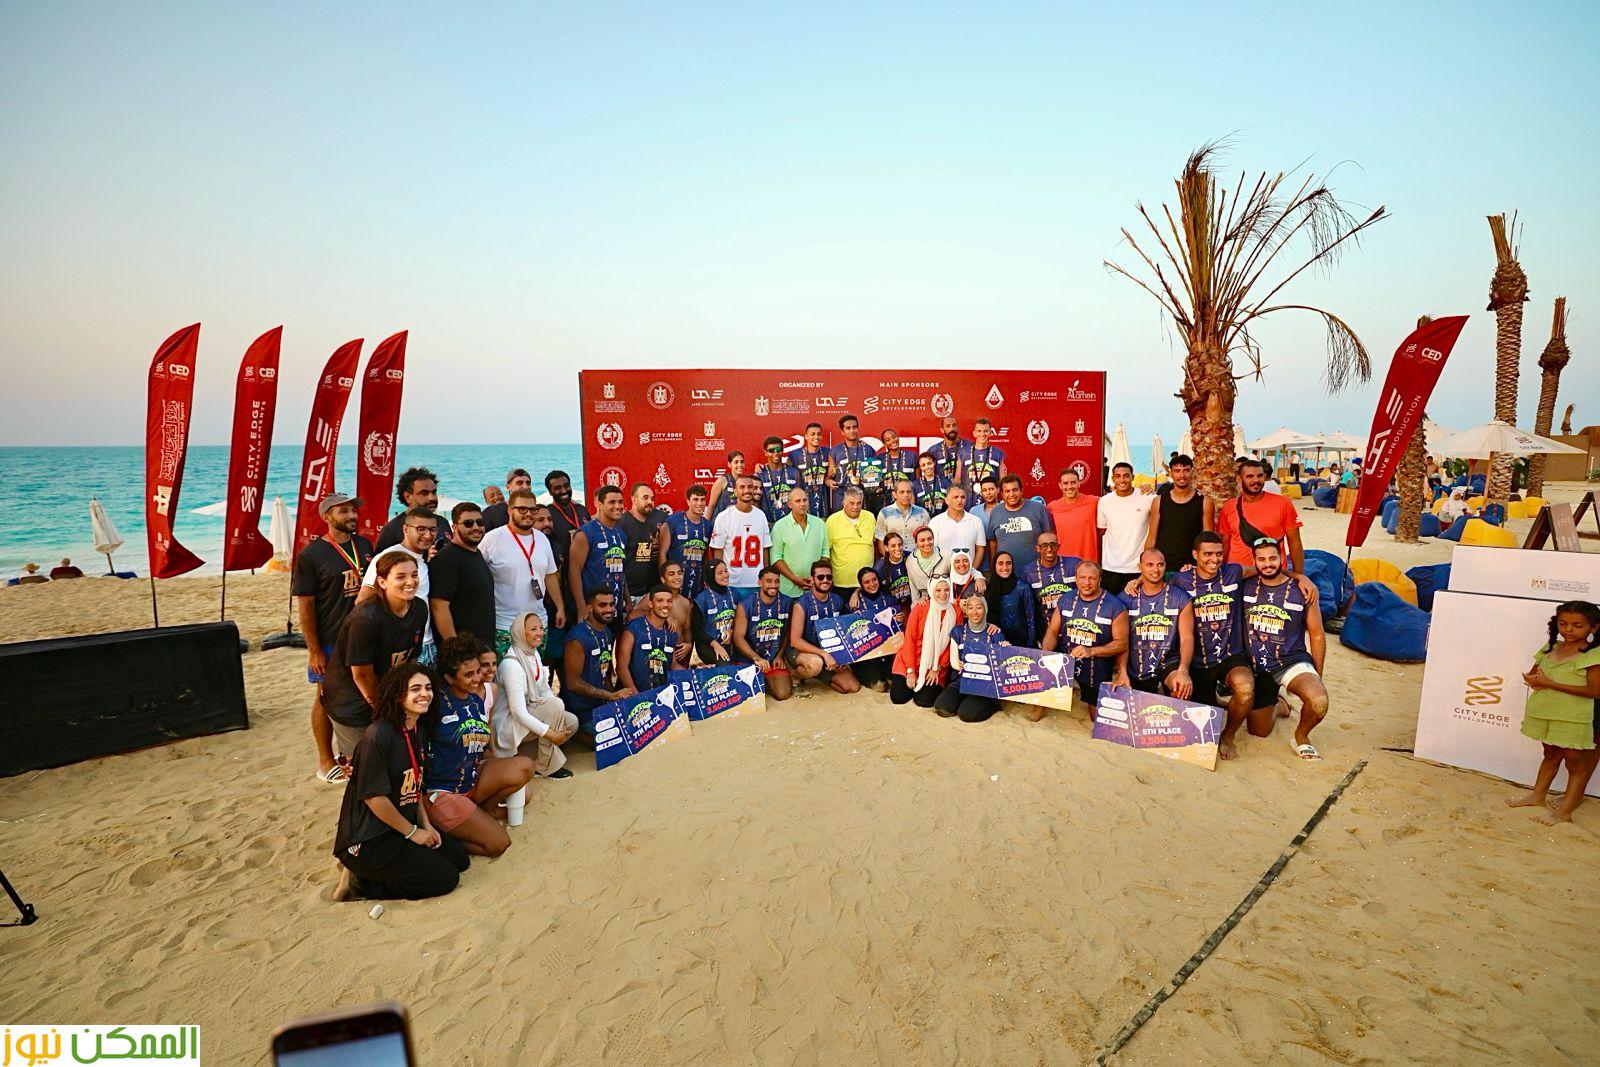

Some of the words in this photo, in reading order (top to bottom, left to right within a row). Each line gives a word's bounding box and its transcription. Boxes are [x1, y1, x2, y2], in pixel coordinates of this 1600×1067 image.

[1421, 347, 1442, 361] CED
[169, 364, 190, 376] CED
[386, 369, 403, 379] CED
[250, 400, 260, 439] EDGE
[253, 401, 267, 480] DEVELOPMENTS
[1377, 457, 1390, 478] LIVE
[1387, 394, 1422, 455] PRODUCTION
[247, 444, 256, 479] CITY
[730, 535, 760, 568] 18
[862, 631, 878, 643] PLACE
[1019, 674, 1040, 683] PLACE
[1028, 681, 1045, 690] EGP
[707, 696, 719, 706] 6TH
[719, 689, 738, 701] PLACE
[728, 694, 742, 705] EGP
[1453, 714, 1510, 728] DEVELOPMENTS
[1454, 707, 1478, 717] CITY
[1481, 712, 1510, 723] EDGE
[632, 727, 645, 739] 7TH
[643, 714, 661, 731] PLACE
[652, 719, 666, 734] EGP
[1142, 728, 1157, 736] 5TH
[1158, 727, 1182, 735] PLACE
[1168, 735, 1187, 744] EGP
